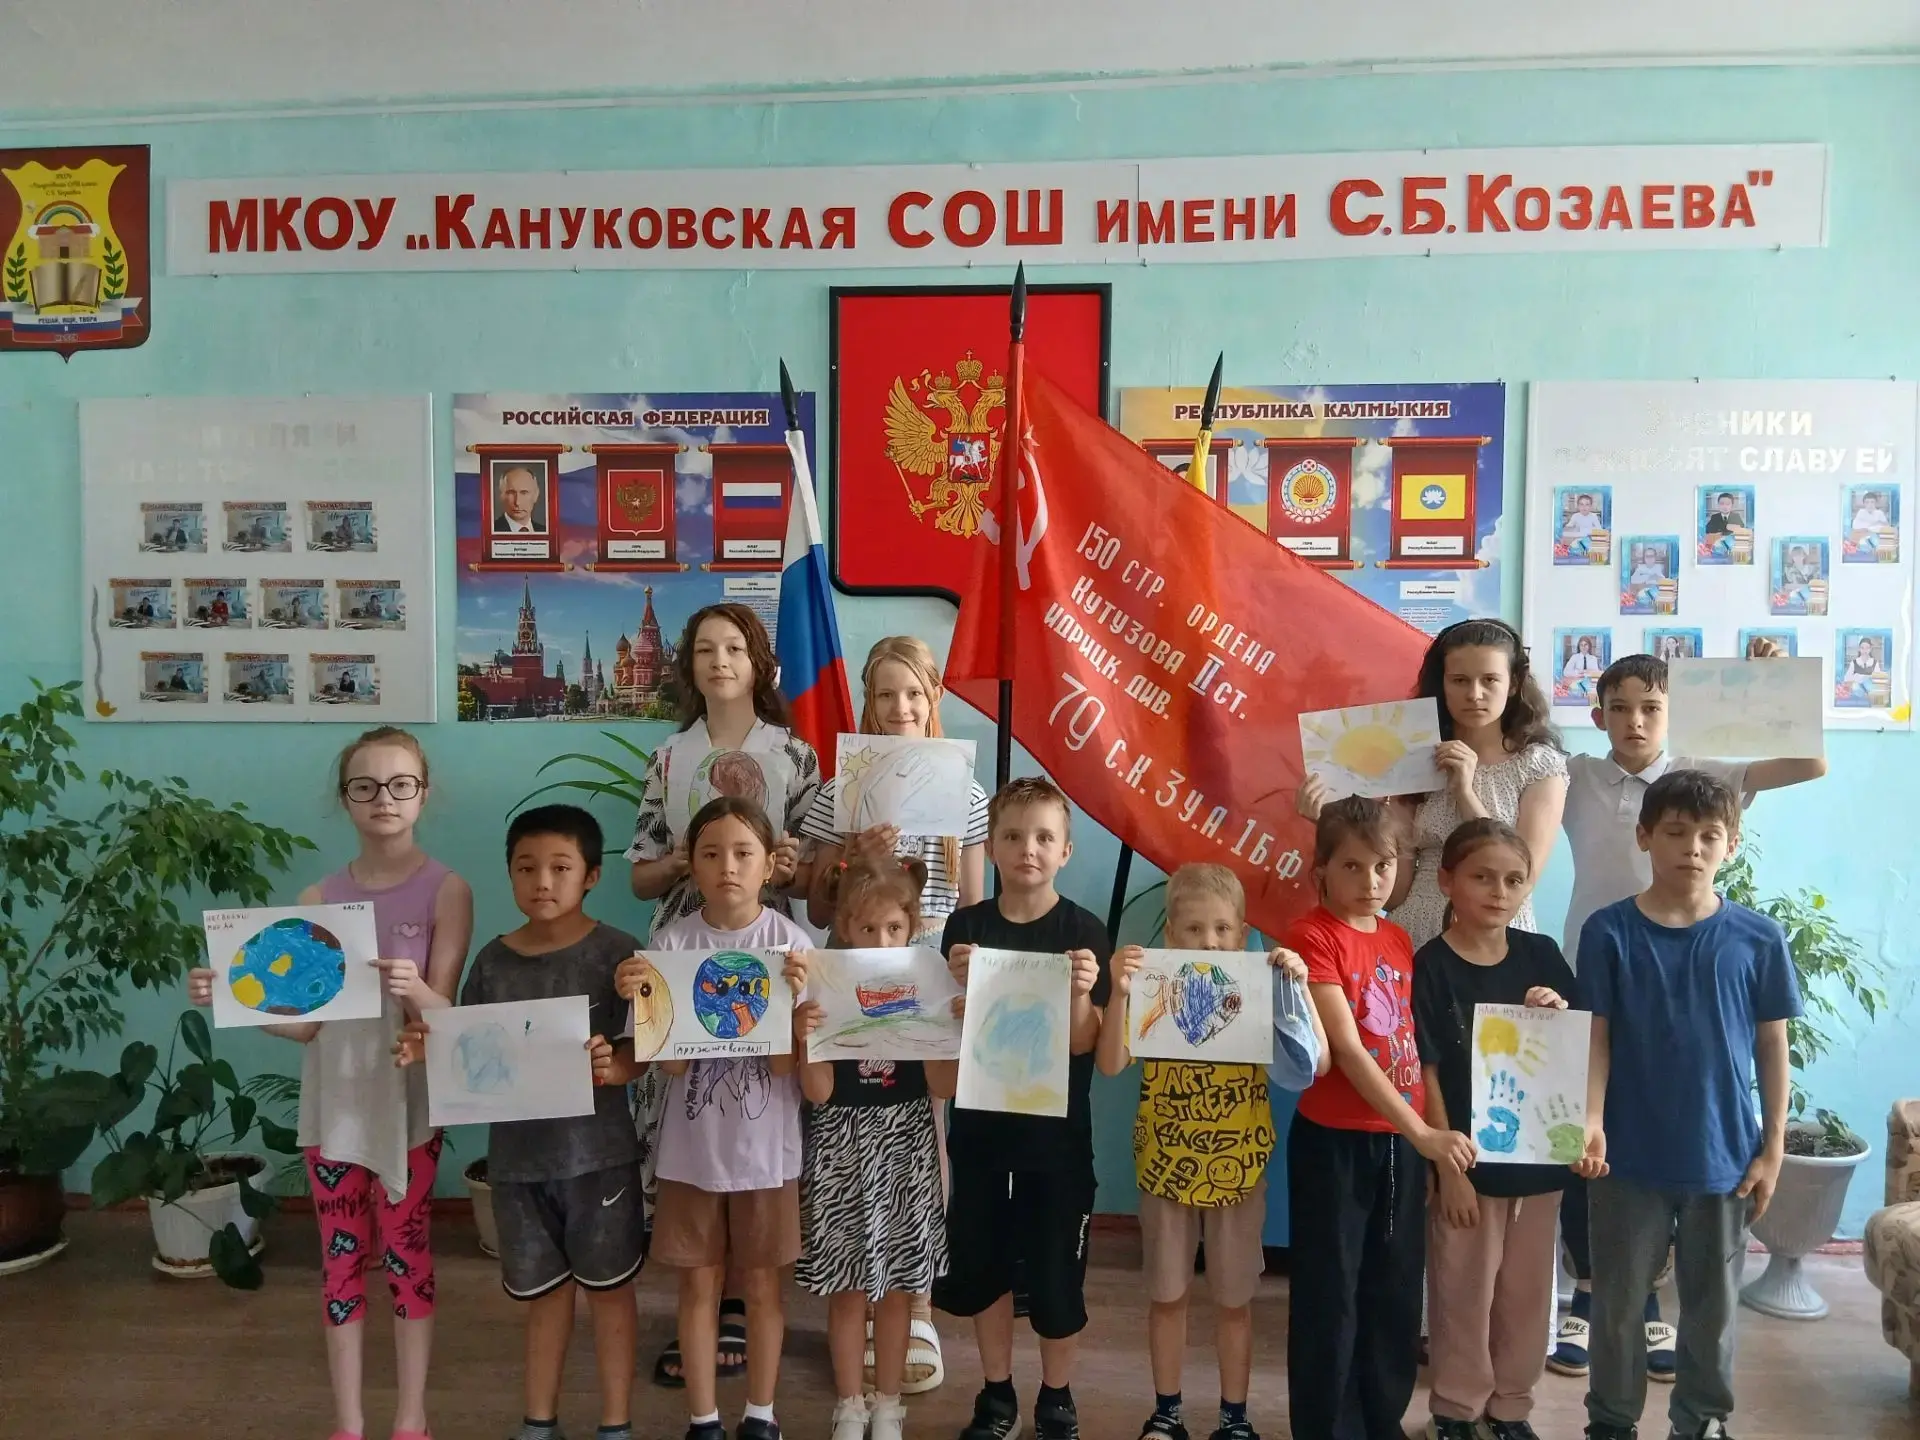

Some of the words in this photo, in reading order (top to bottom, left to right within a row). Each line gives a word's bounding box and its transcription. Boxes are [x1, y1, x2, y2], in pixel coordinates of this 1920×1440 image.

[209, 197, 396, 252] МКОУ
[887, 188, 1064, 248] СОШ
[502, 406, 634, 426] РОССИЙСКАЯ
[642, 408, 770, 427] ФЕДЕРАЦИЯ
[1174, 403, 1314, 420] РЕПУБЛИКА
[1323, 401, 1451, 419] КАЛМЫКИЯ
[1739, 446, 1846, 474] СЛАВУ
[1076, 521, 1121, 571] 150
[1186, 603, 1277, 676] ОРДЕНА
[1047, 672, 1107, 752] 79
[1163, 1064, 1214, 1095] ART
[1154, 1077, 1247, 1121] STREET
[1563, 1320, 1587, 1334] NIKE
[1648, 1326, 1671, 1337] NIKE
